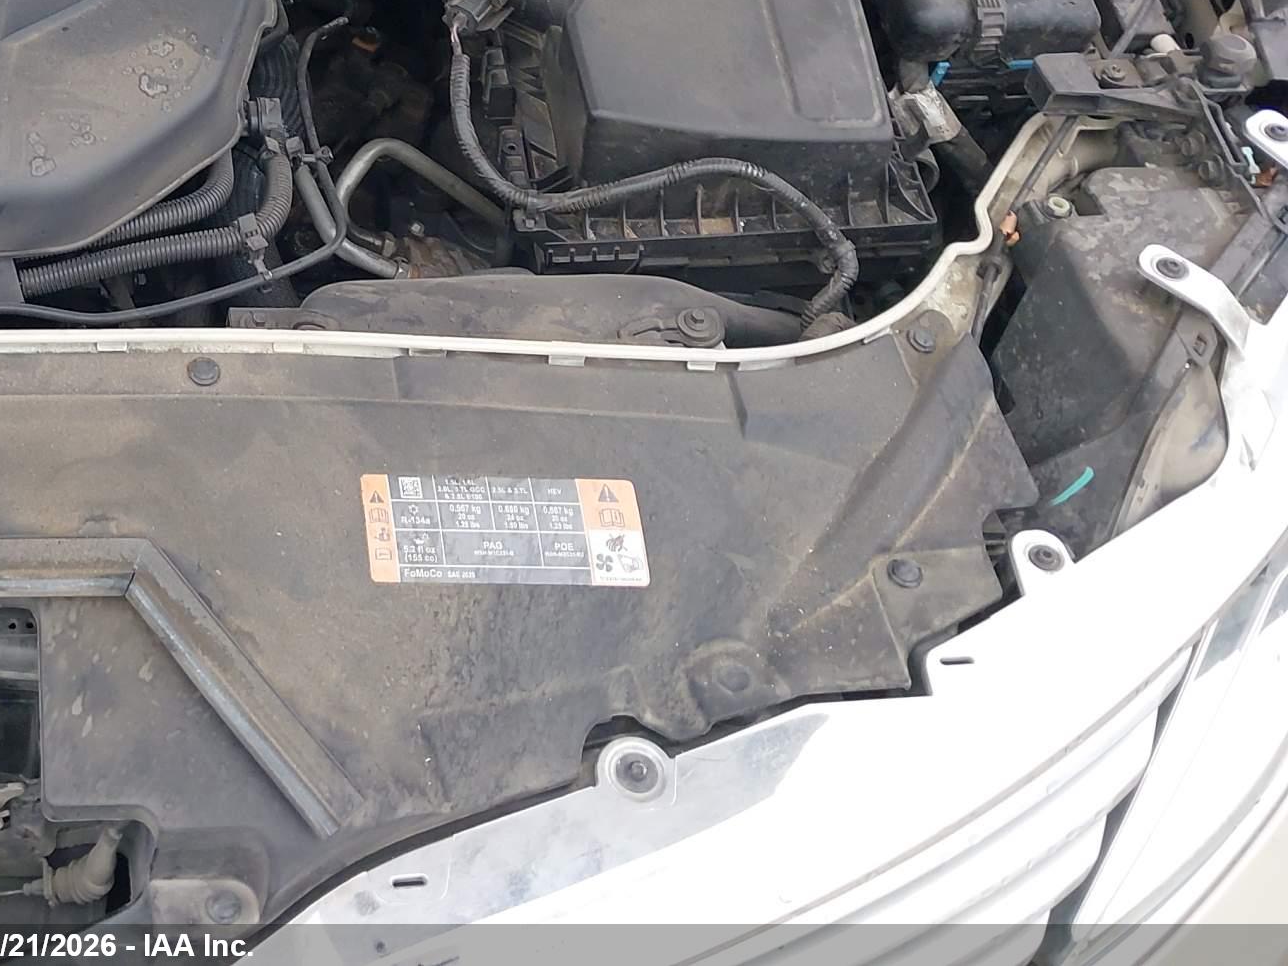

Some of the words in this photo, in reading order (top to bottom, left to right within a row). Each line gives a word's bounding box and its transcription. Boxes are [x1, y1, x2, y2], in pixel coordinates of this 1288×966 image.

[471, 505, 481, 514] kg
[519, 506, 529, 515] kg
[564, 506, 574, 516] kg
[401, 516, 431, 525] R-134a
[483, 541, 503, 550] PAG
[554, 542, 574, 551] POE
[405, 553, 423, 562] (155
[424, 554, 438, 562] cc)
[404, 568, 442, 578] FoMoCo
